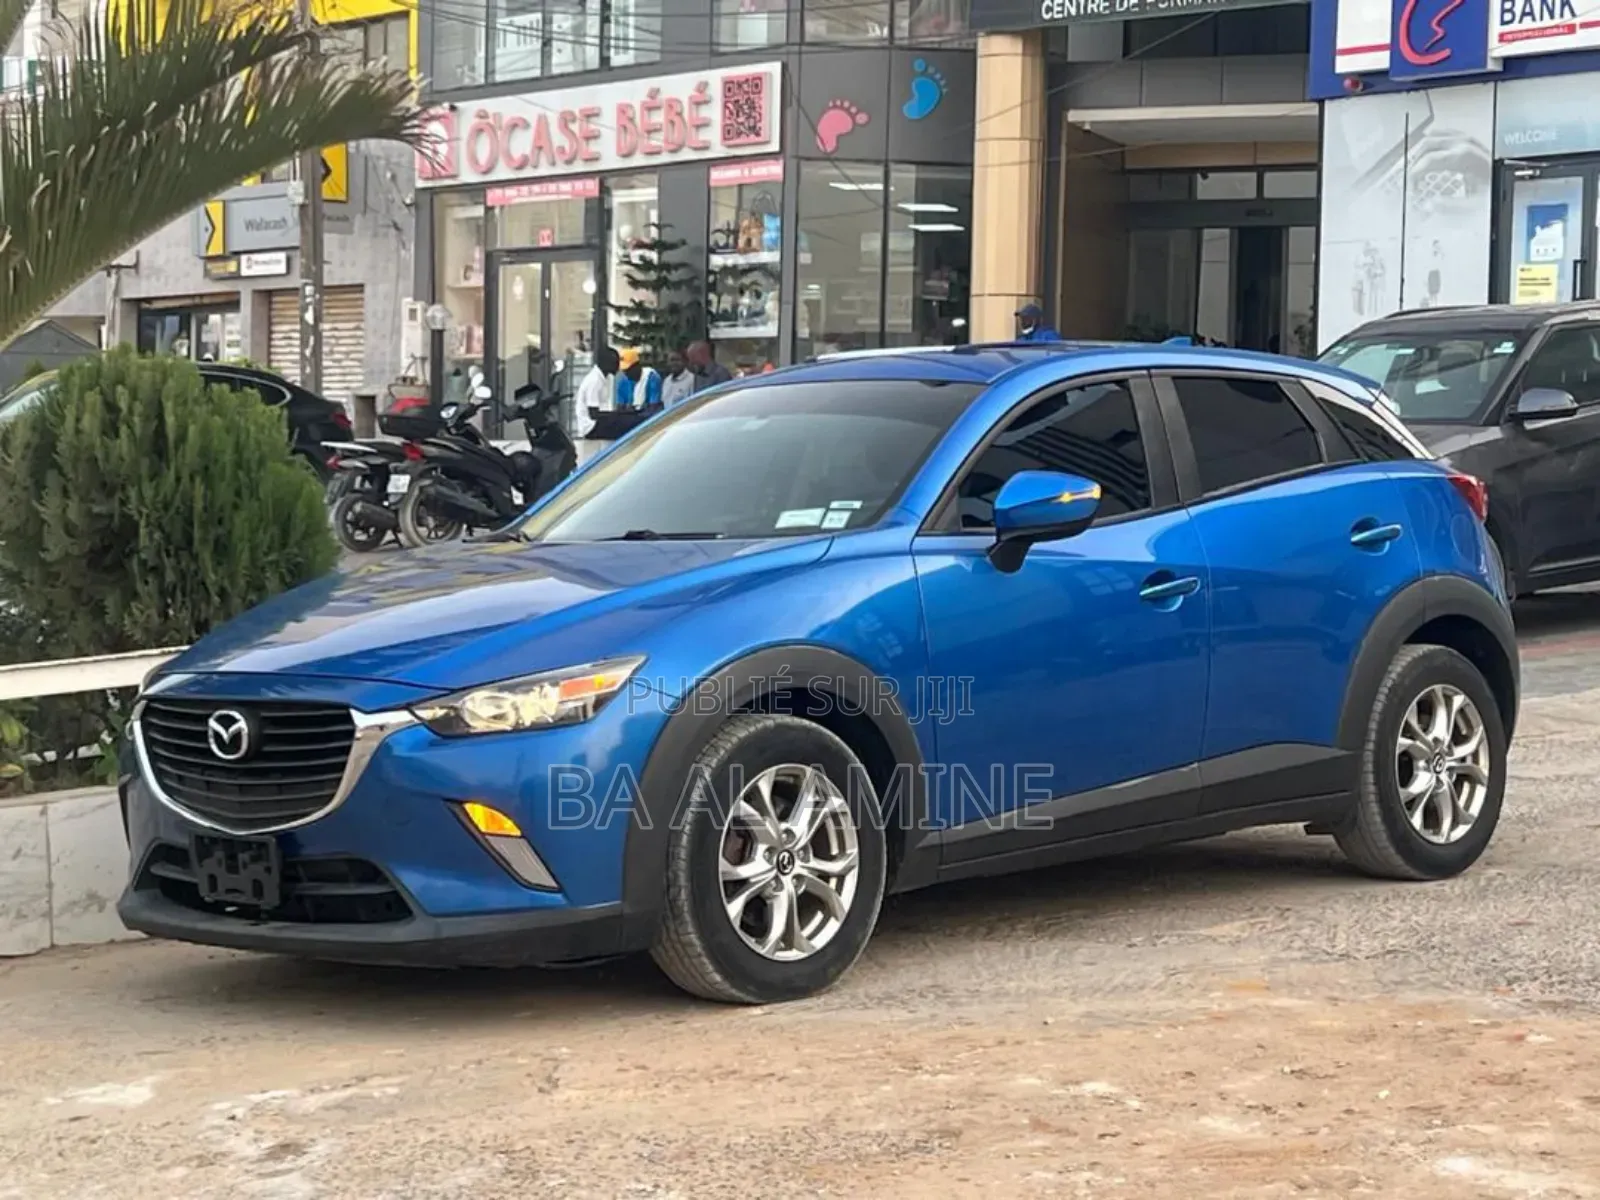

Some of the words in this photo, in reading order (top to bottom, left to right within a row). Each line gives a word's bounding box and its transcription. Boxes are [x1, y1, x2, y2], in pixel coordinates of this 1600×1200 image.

[1041, 0, 1110, 20] CENTRE
[1500, 0, 1577, 26] BANK
[615, 80, 711, 158] BÉBÉ
